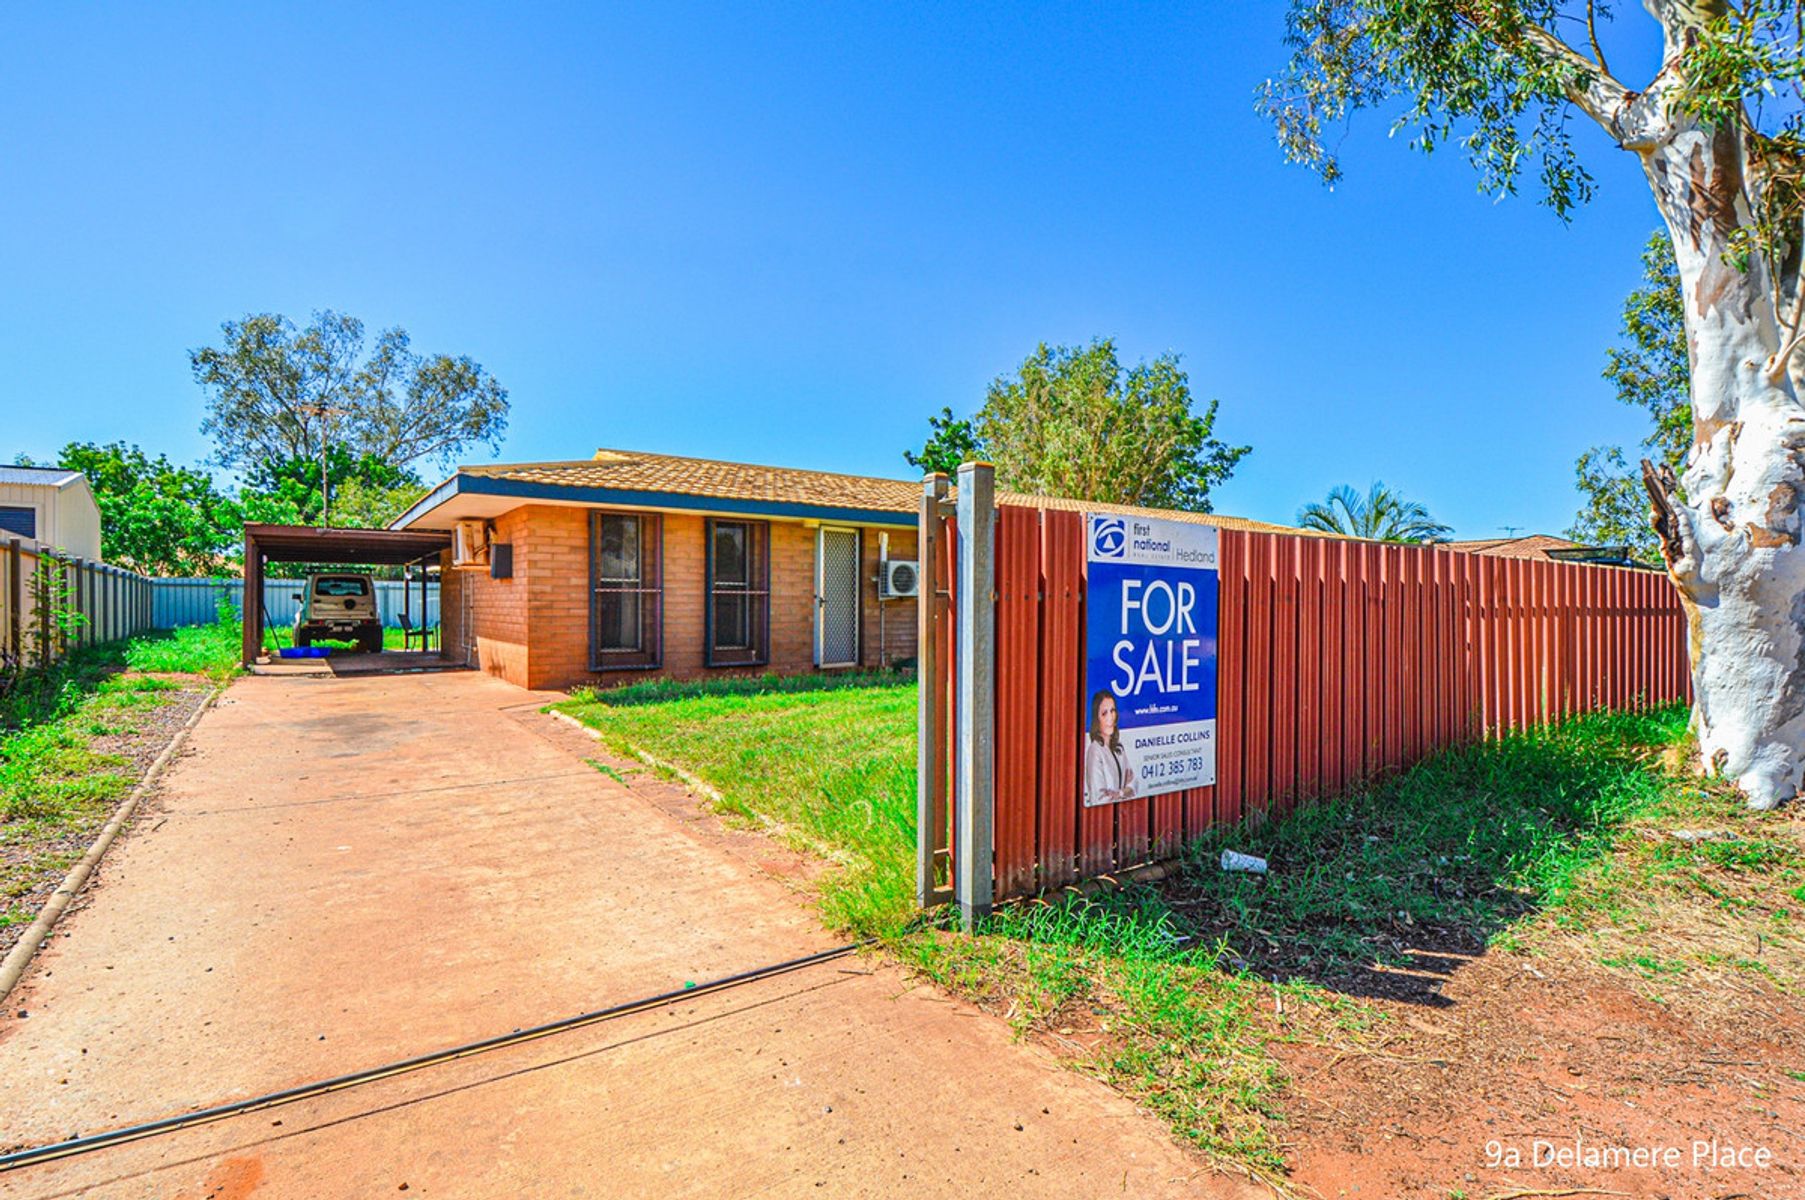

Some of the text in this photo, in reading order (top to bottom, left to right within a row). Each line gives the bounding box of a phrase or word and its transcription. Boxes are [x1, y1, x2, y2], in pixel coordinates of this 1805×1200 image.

[1133, 522, 1150, 536] first
[1133, 538, 1171, 552] national
[1176, 548, 1215, 563] Hedland
[1121, 579, 1197, 636] FOR
[1110, 639, 1200, 697] SALE
[1135, 730, 1210, 749] DANIELLE COLLINS
[1141, 756, 1203, 779] 0412 385 783
